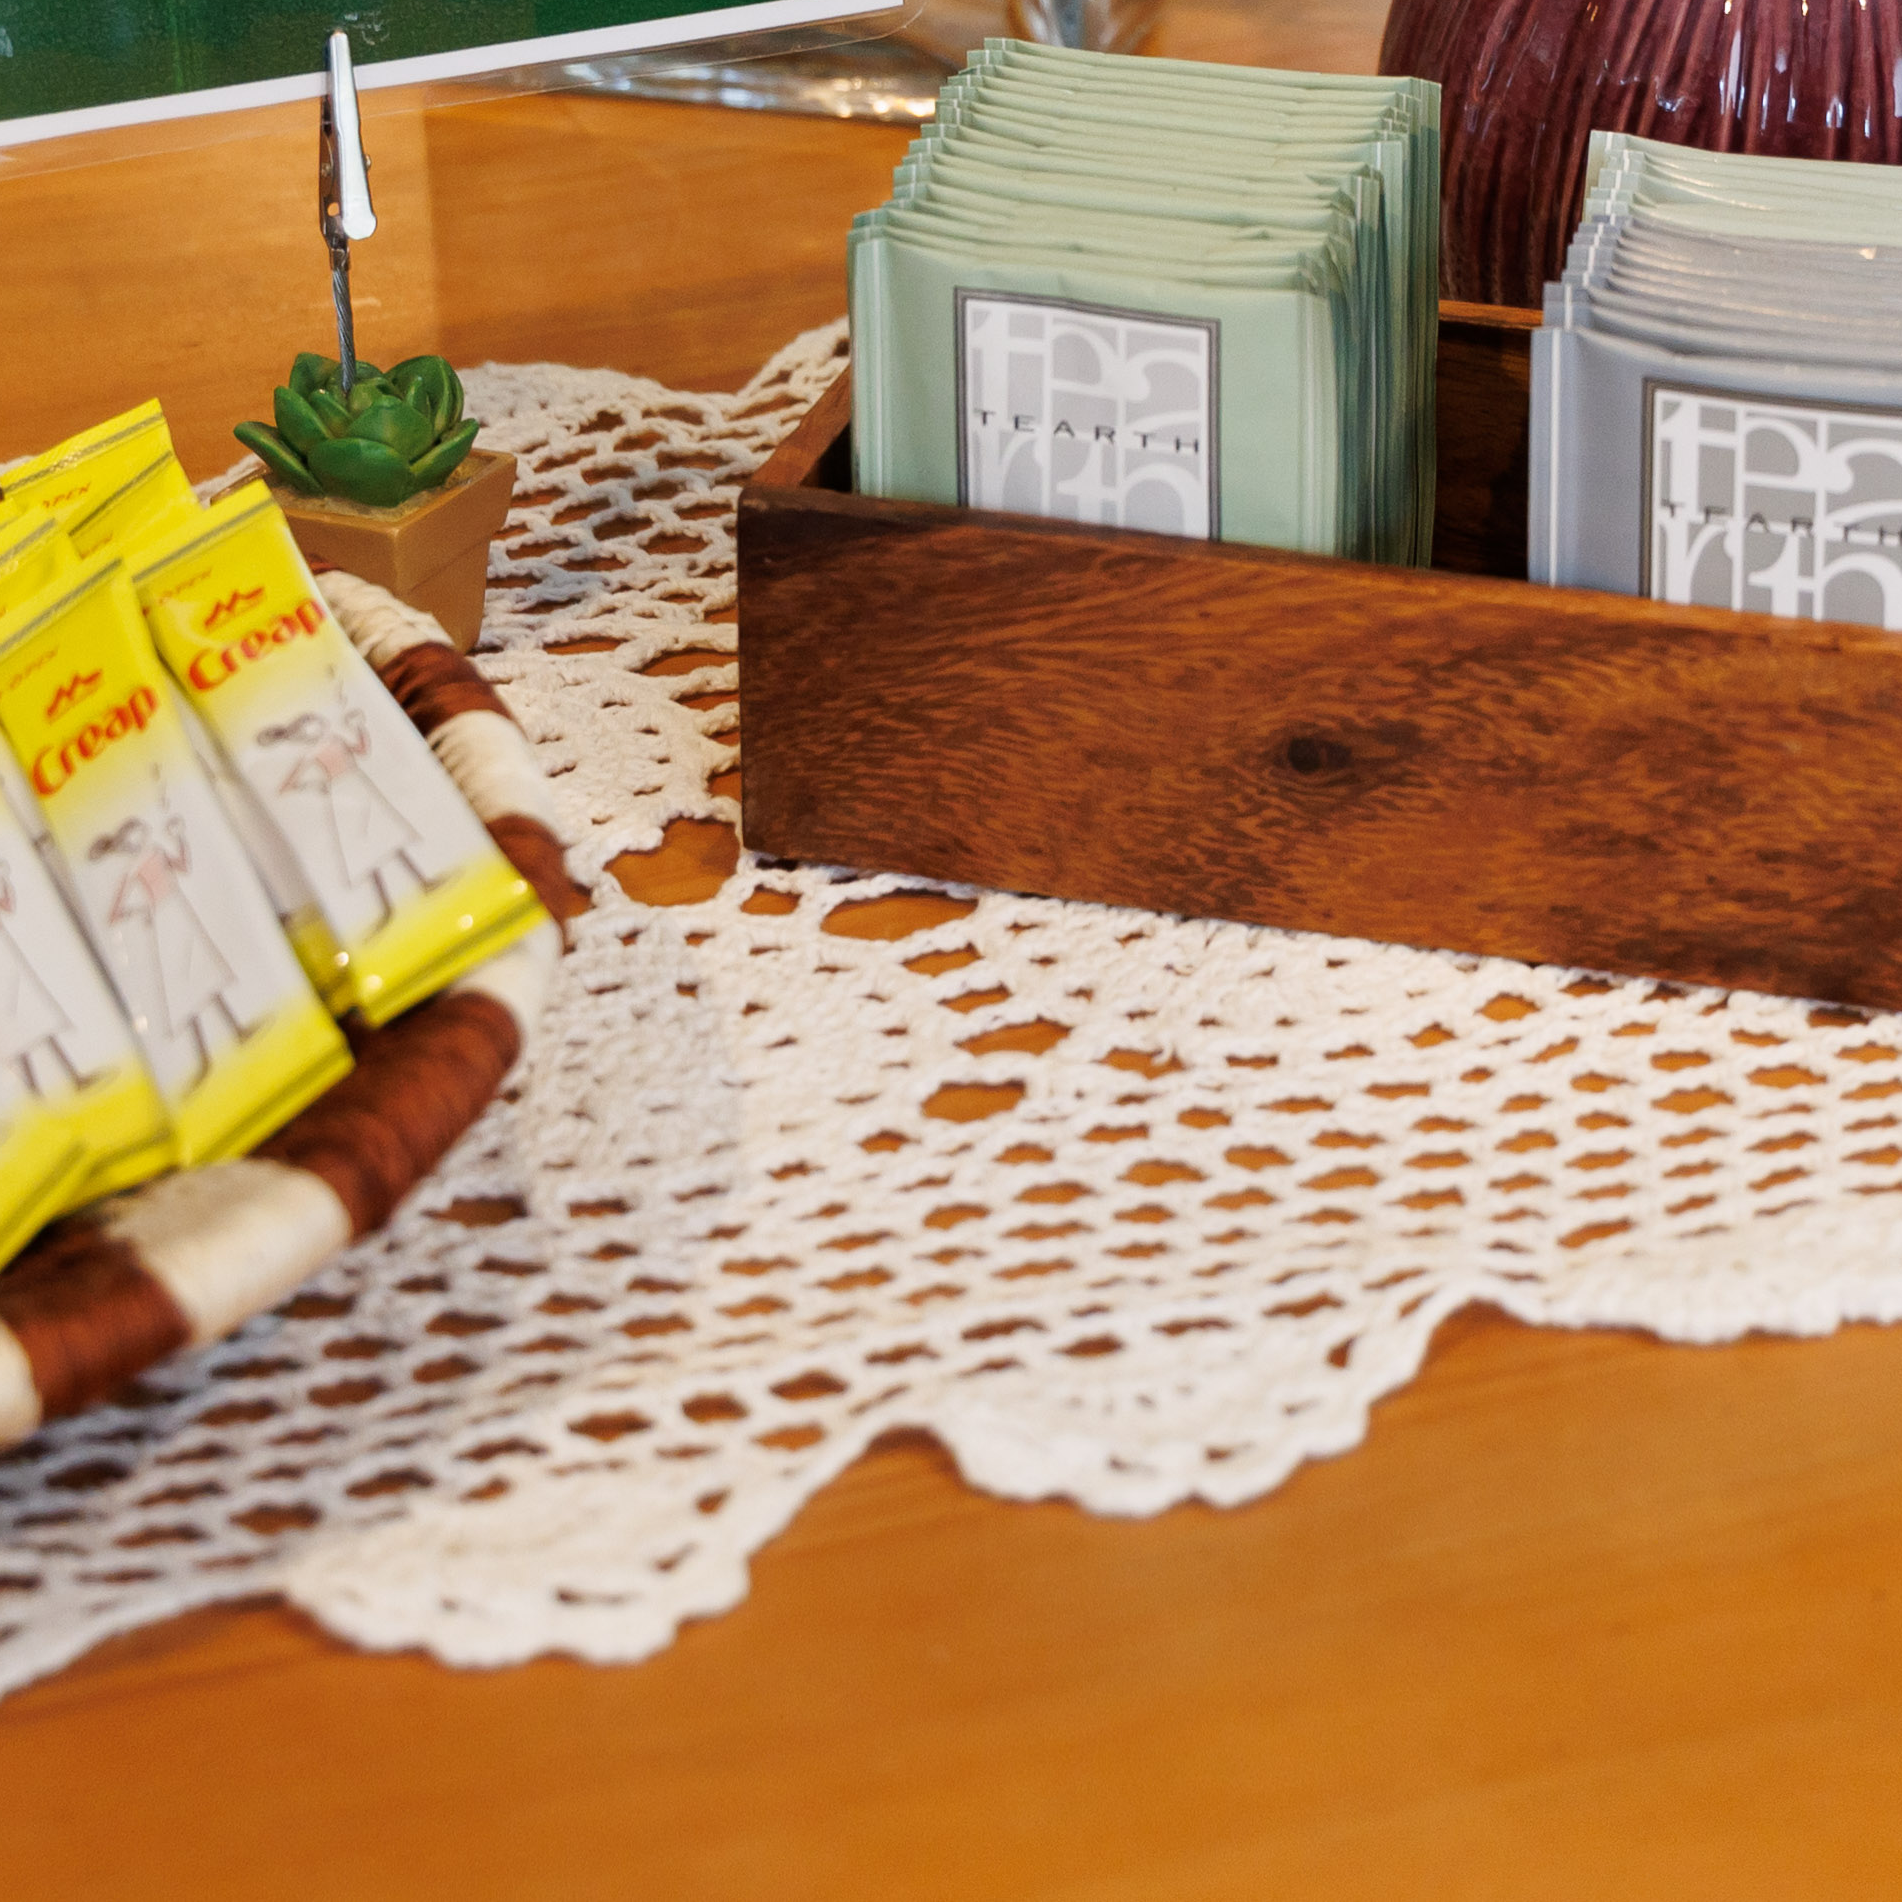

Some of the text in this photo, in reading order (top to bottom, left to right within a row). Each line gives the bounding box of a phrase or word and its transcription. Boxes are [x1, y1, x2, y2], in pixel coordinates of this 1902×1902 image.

[972, 407, 1200, 455] TEARTH
[186, 597, 327, 693] Creap
[30, 685, 160, 797] Creap
